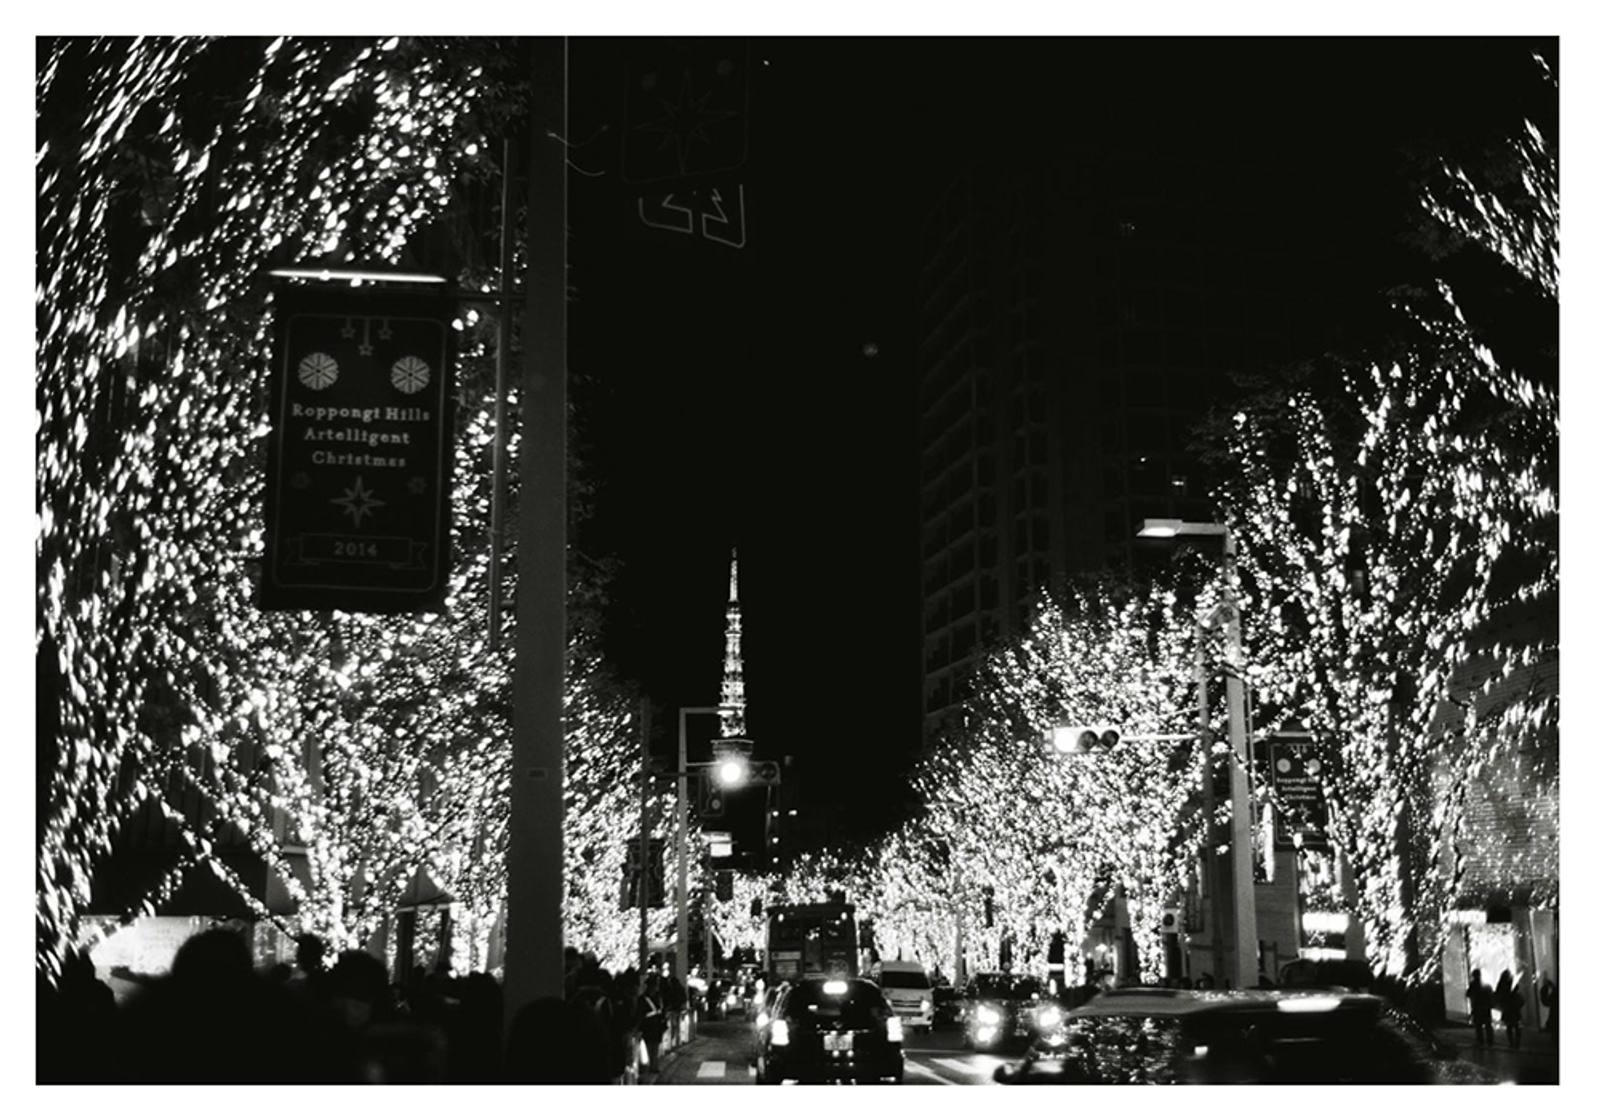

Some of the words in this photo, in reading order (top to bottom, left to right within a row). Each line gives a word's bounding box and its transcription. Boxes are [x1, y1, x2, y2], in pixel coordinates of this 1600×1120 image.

[291, 403, 380, 423] Roppongi
[384, 407, 431, 421] Hills
[304, 427, 411, 447] Artelligent
[311, 450, 406, 468] Christmas
[333, 541, 378, 557] 2014
